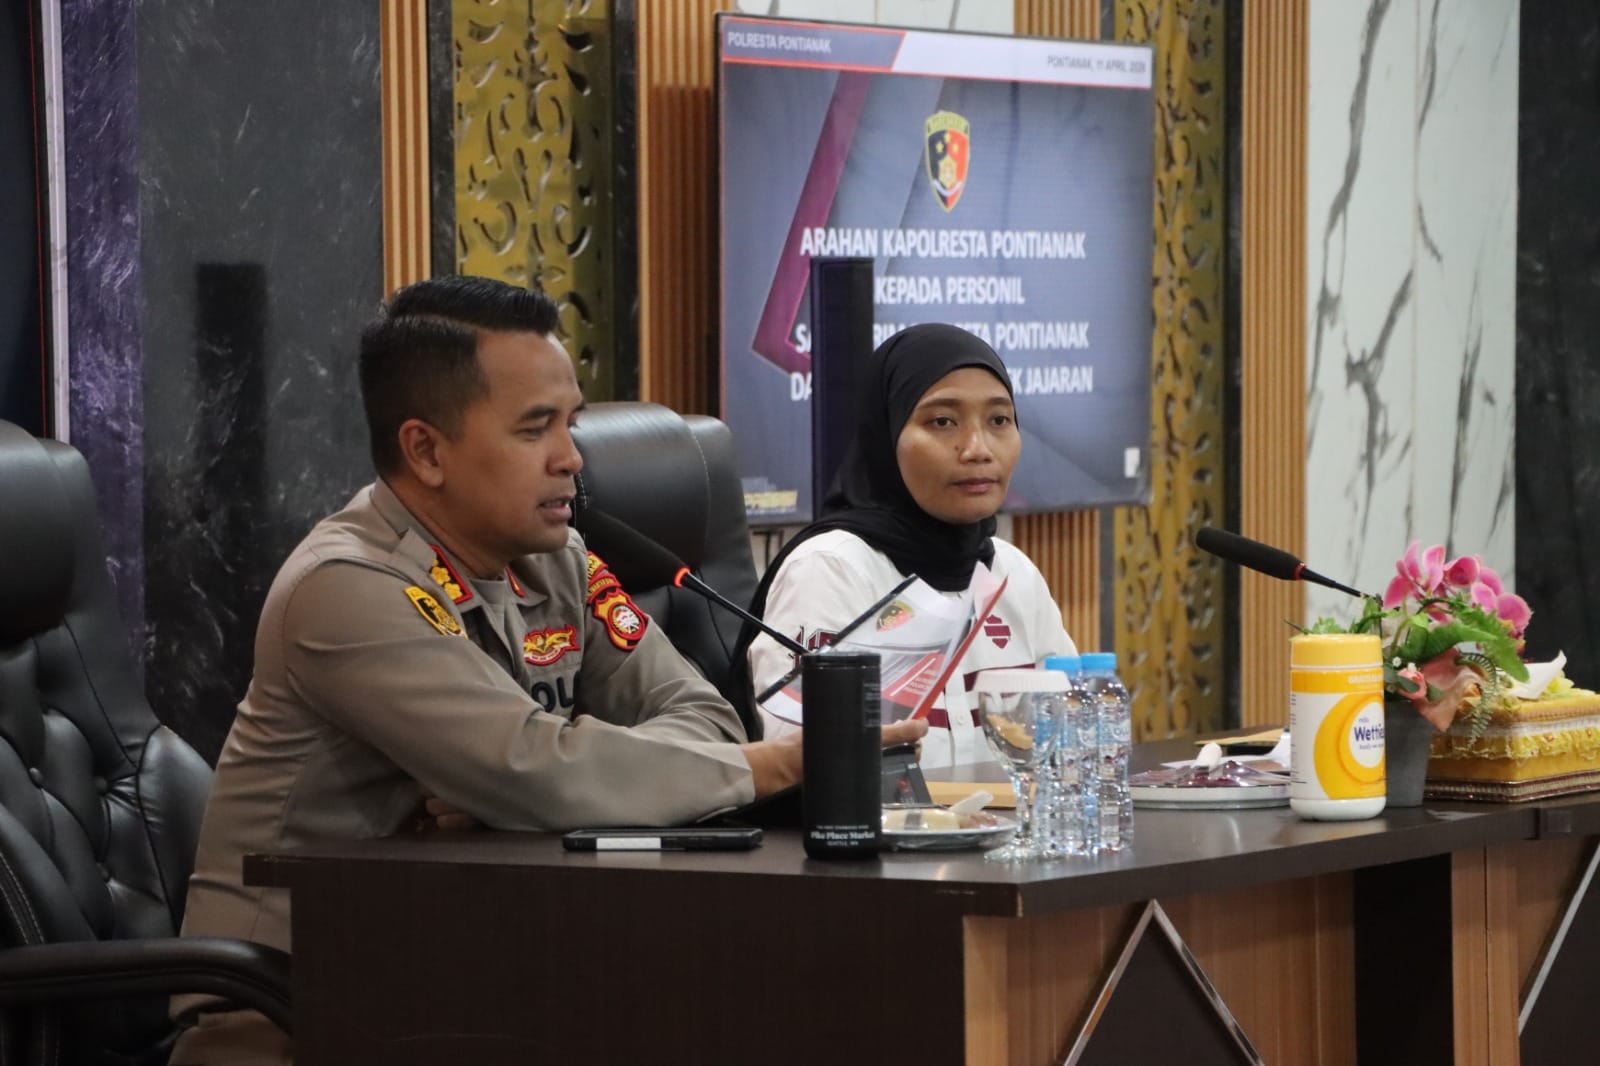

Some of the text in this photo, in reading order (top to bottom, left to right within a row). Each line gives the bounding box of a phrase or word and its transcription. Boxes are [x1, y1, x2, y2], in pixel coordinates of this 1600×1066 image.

[728, 32, 832, 53] POLRESTA PONTIANAK
[800, 227, 1087, 259] ARAHAN KAPOLRESTA PONTIANAK
[874, 276, 1025, 305] KEPADA PERSONIL
[994, 321, 1090, 350] PONTIANAK
[1024, 365, 1094, 395] JAJARAN
